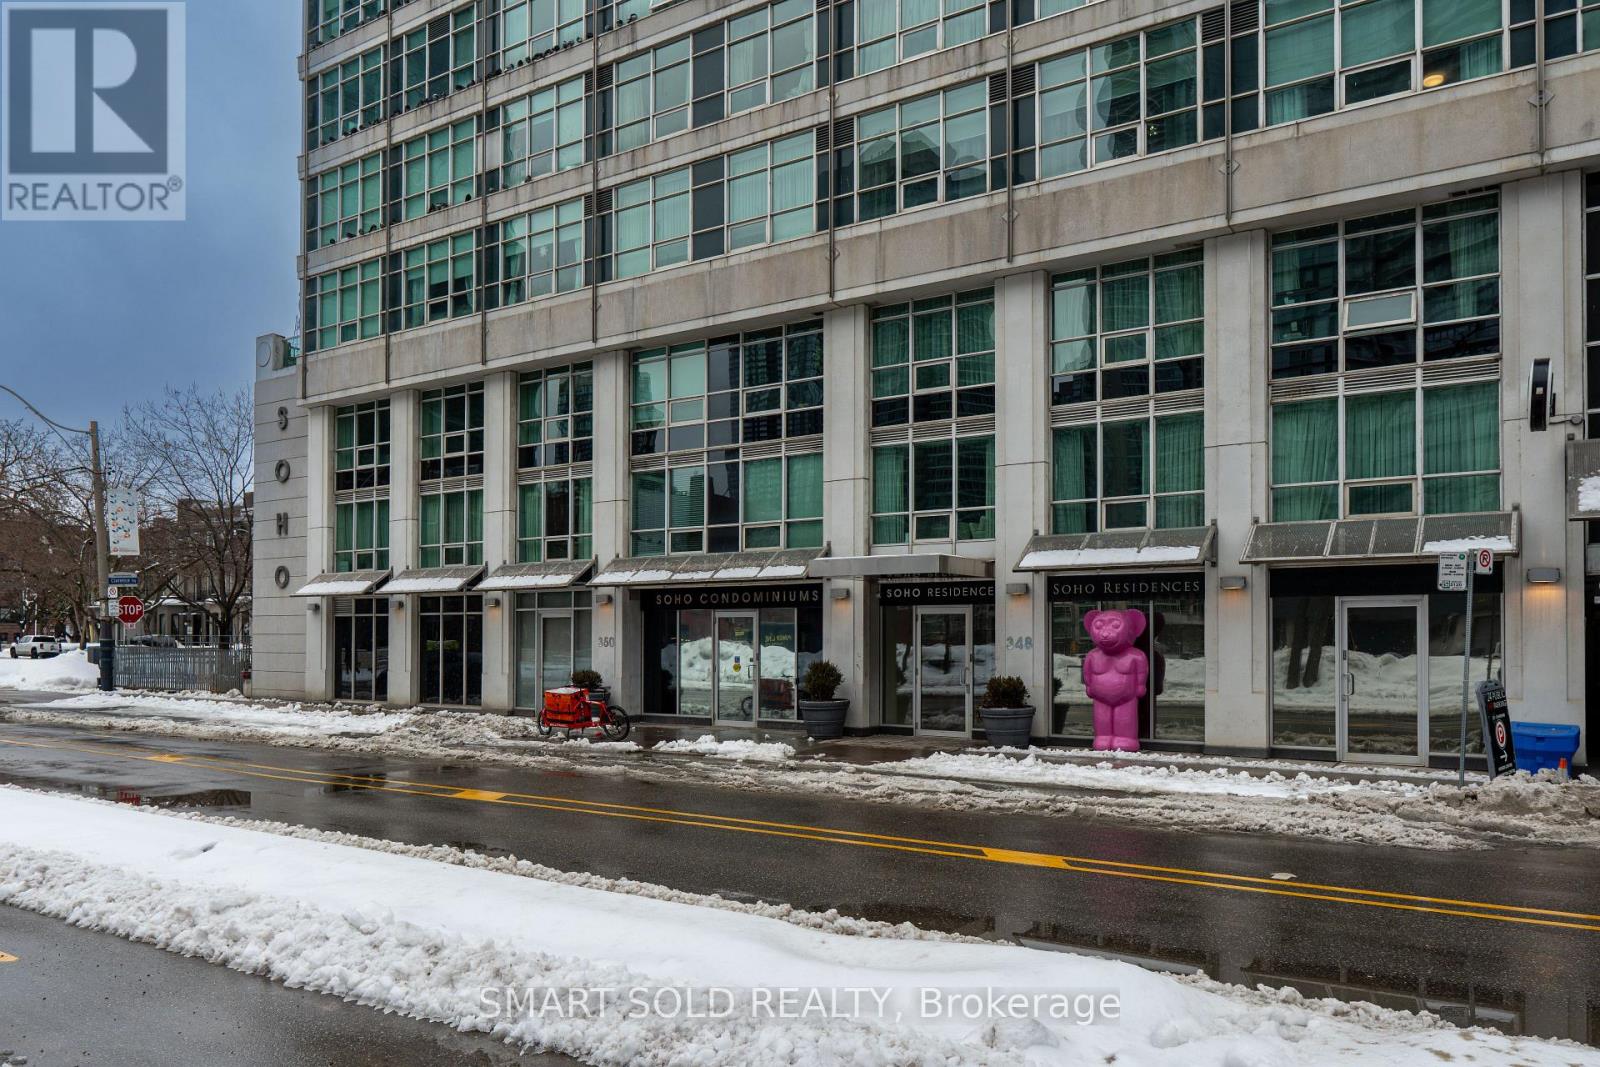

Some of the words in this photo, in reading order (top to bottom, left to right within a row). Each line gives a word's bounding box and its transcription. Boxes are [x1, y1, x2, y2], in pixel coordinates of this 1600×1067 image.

[886, 588, 921, 598] SOHO
[1053, 583, 1095, 595] SOHO
[1104, 581, 1200, 594] RESIDENCES
[656, 594, 693, 606] SOHO
[700, 590, 820, 605] CONDOMINIUMS
[118, 604, 142, 615] STOP
[1006, 636, 1034, 650] 348
